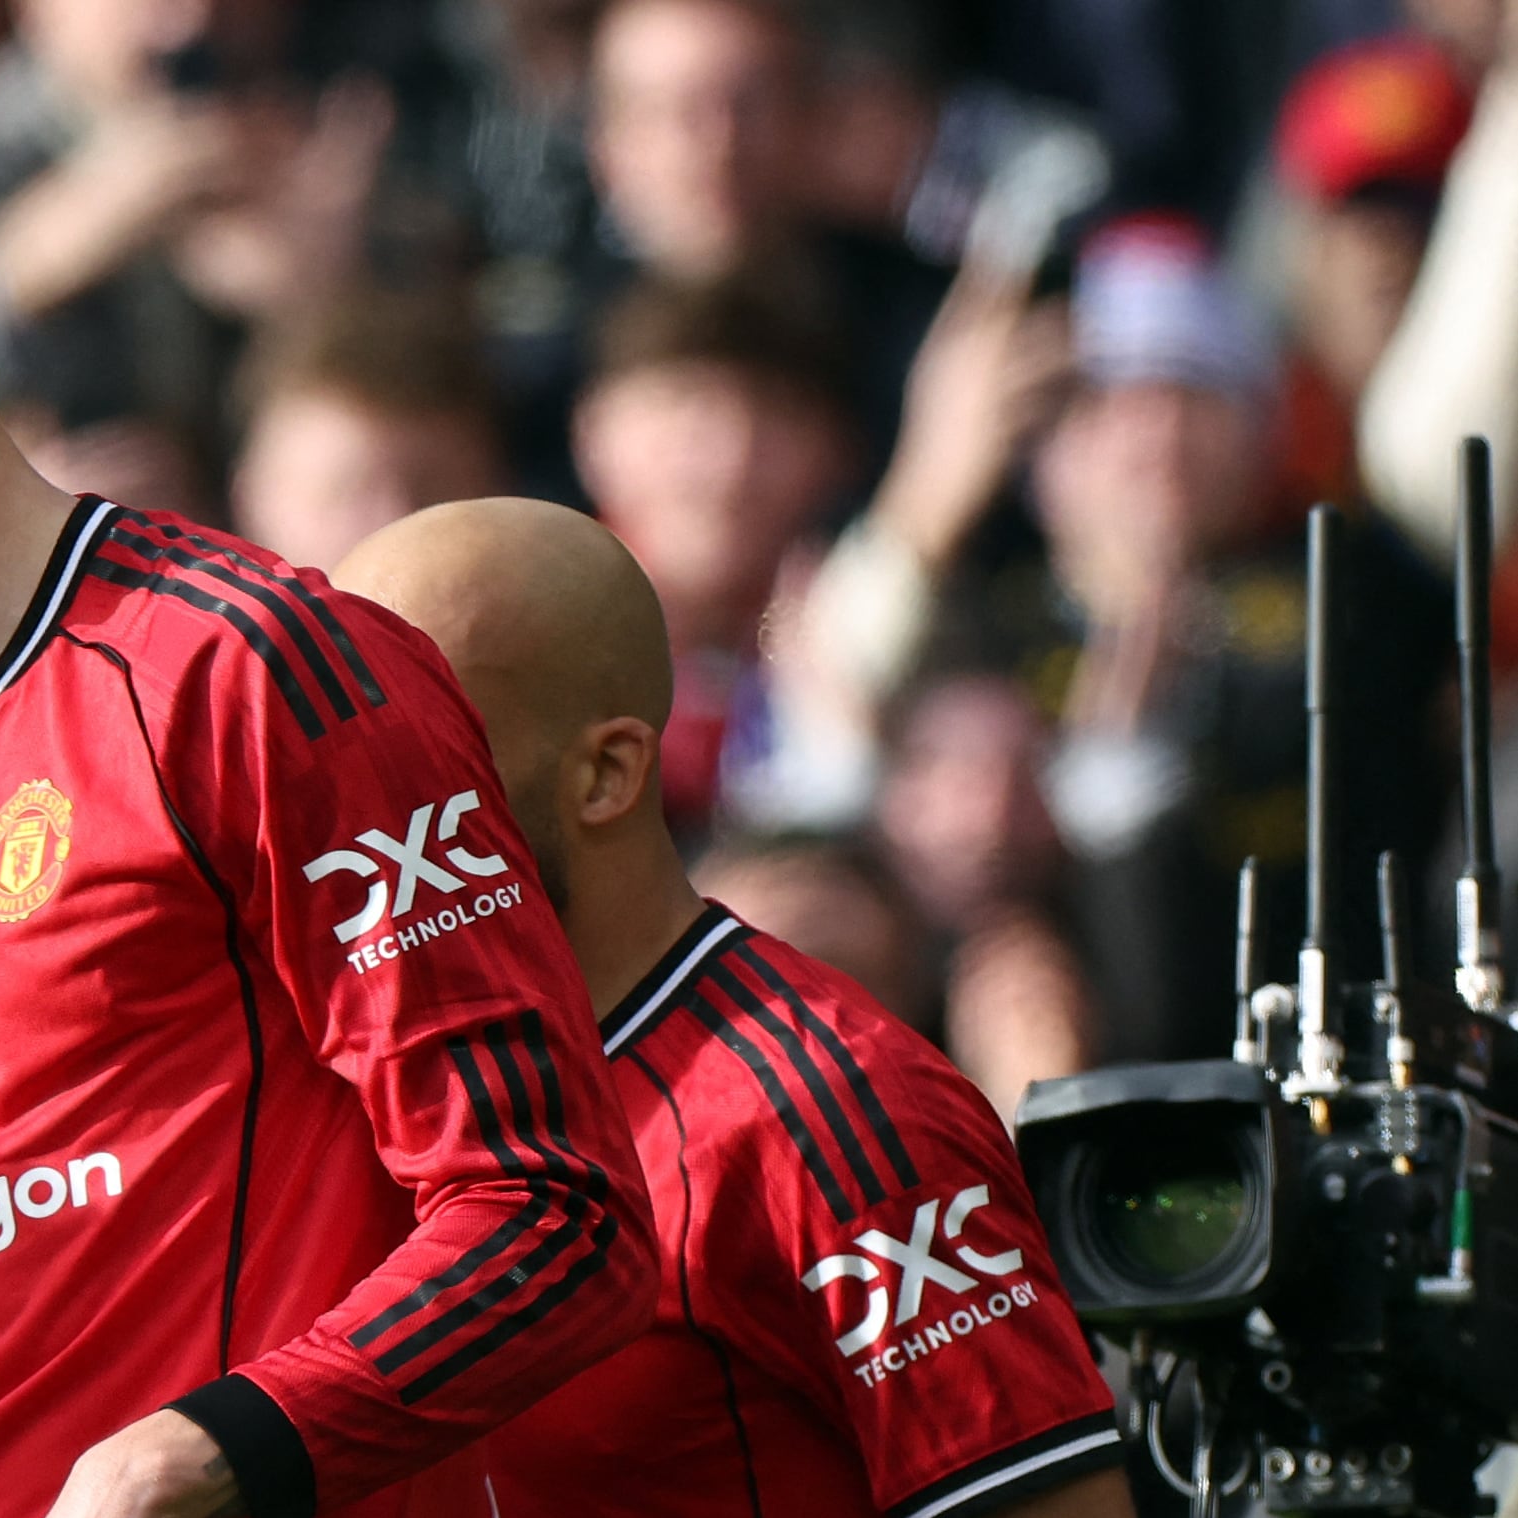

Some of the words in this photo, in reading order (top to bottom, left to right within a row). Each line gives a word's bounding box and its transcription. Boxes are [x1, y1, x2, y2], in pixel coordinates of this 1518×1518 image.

[301, 789, 510, 945] DXC
[346, 882, 523, 976] TECHNOLOGY
[800, 1183, 1024, 1358] DXC
[853, 1280, 1039, 1389] TECHNOLOGY
